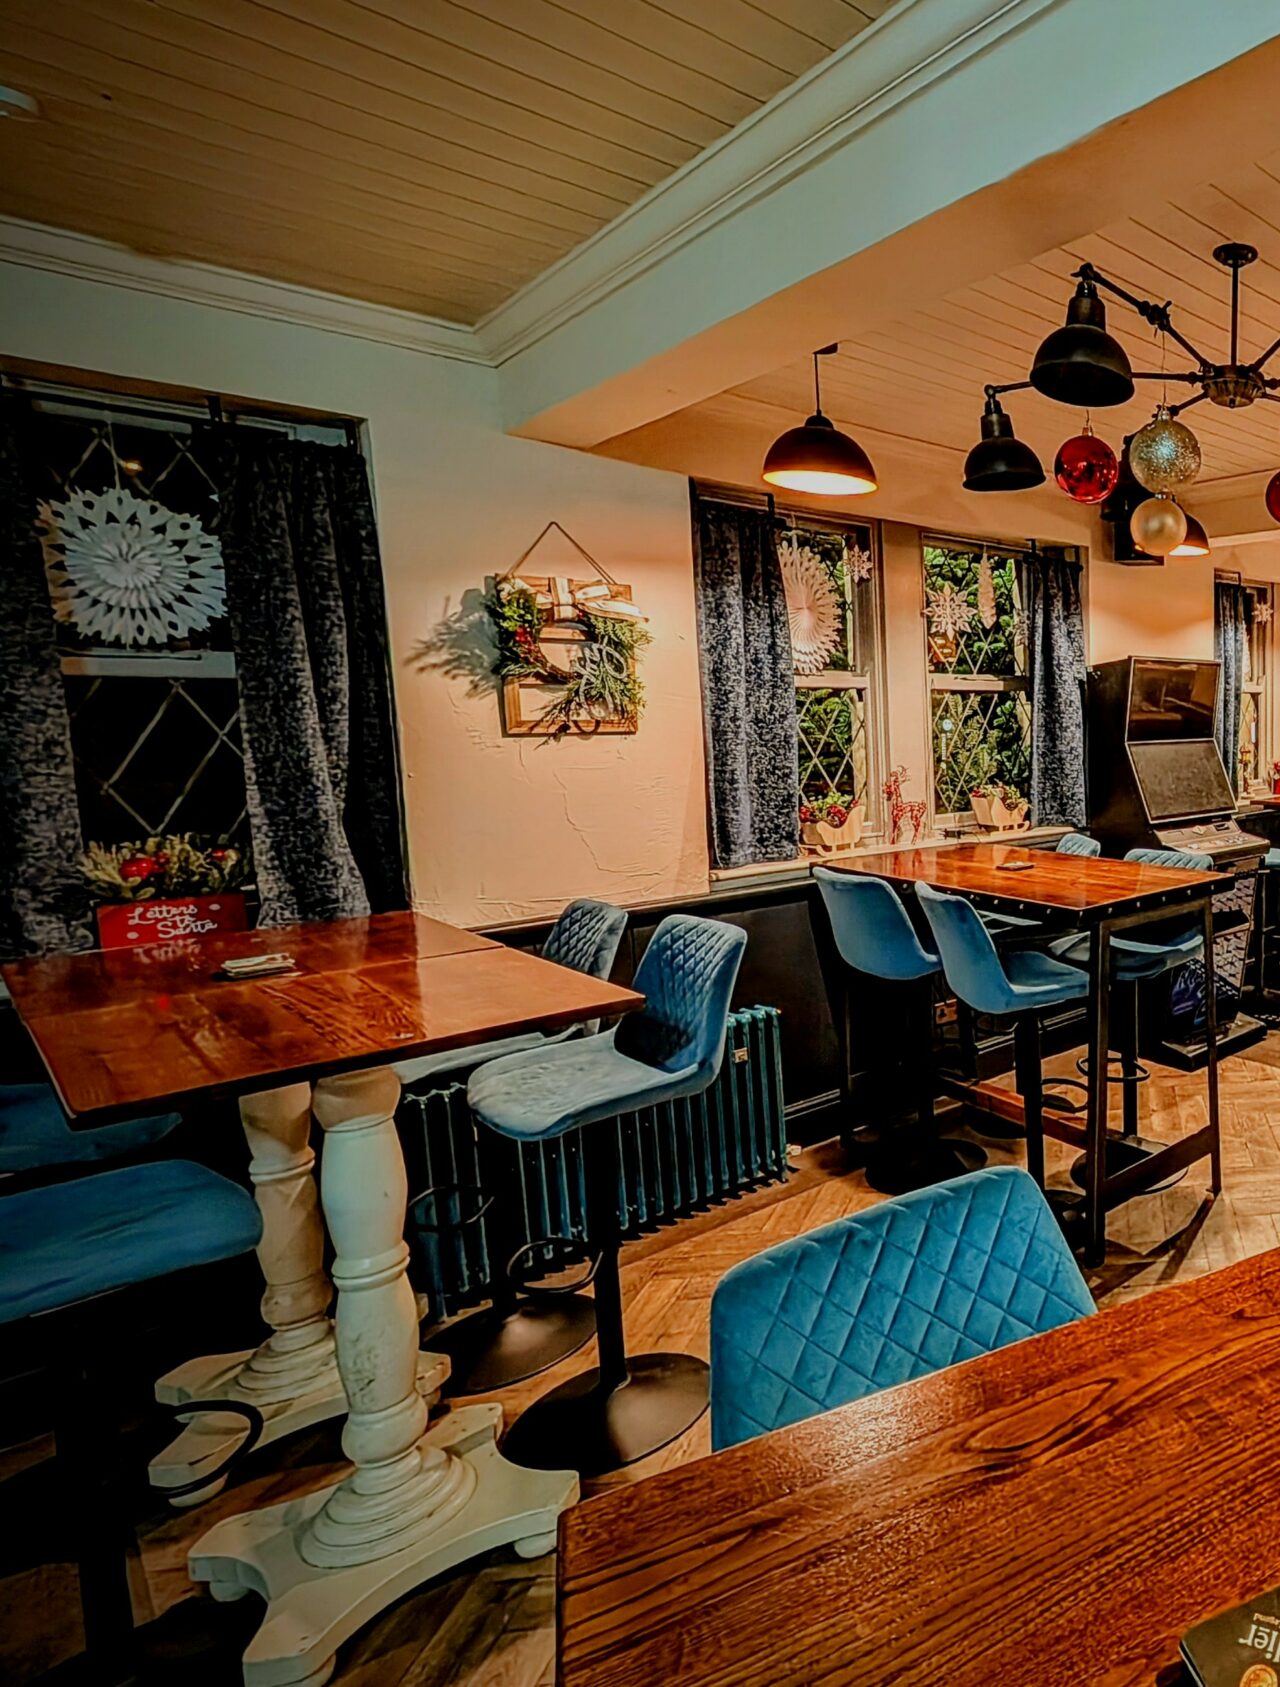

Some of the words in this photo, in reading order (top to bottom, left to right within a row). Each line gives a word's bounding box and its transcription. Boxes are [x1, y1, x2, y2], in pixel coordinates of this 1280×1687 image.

[126, 905, 198, 926] Letters
[167, 914, 197, 928] to
[156, 920, 218, 939] Santa
